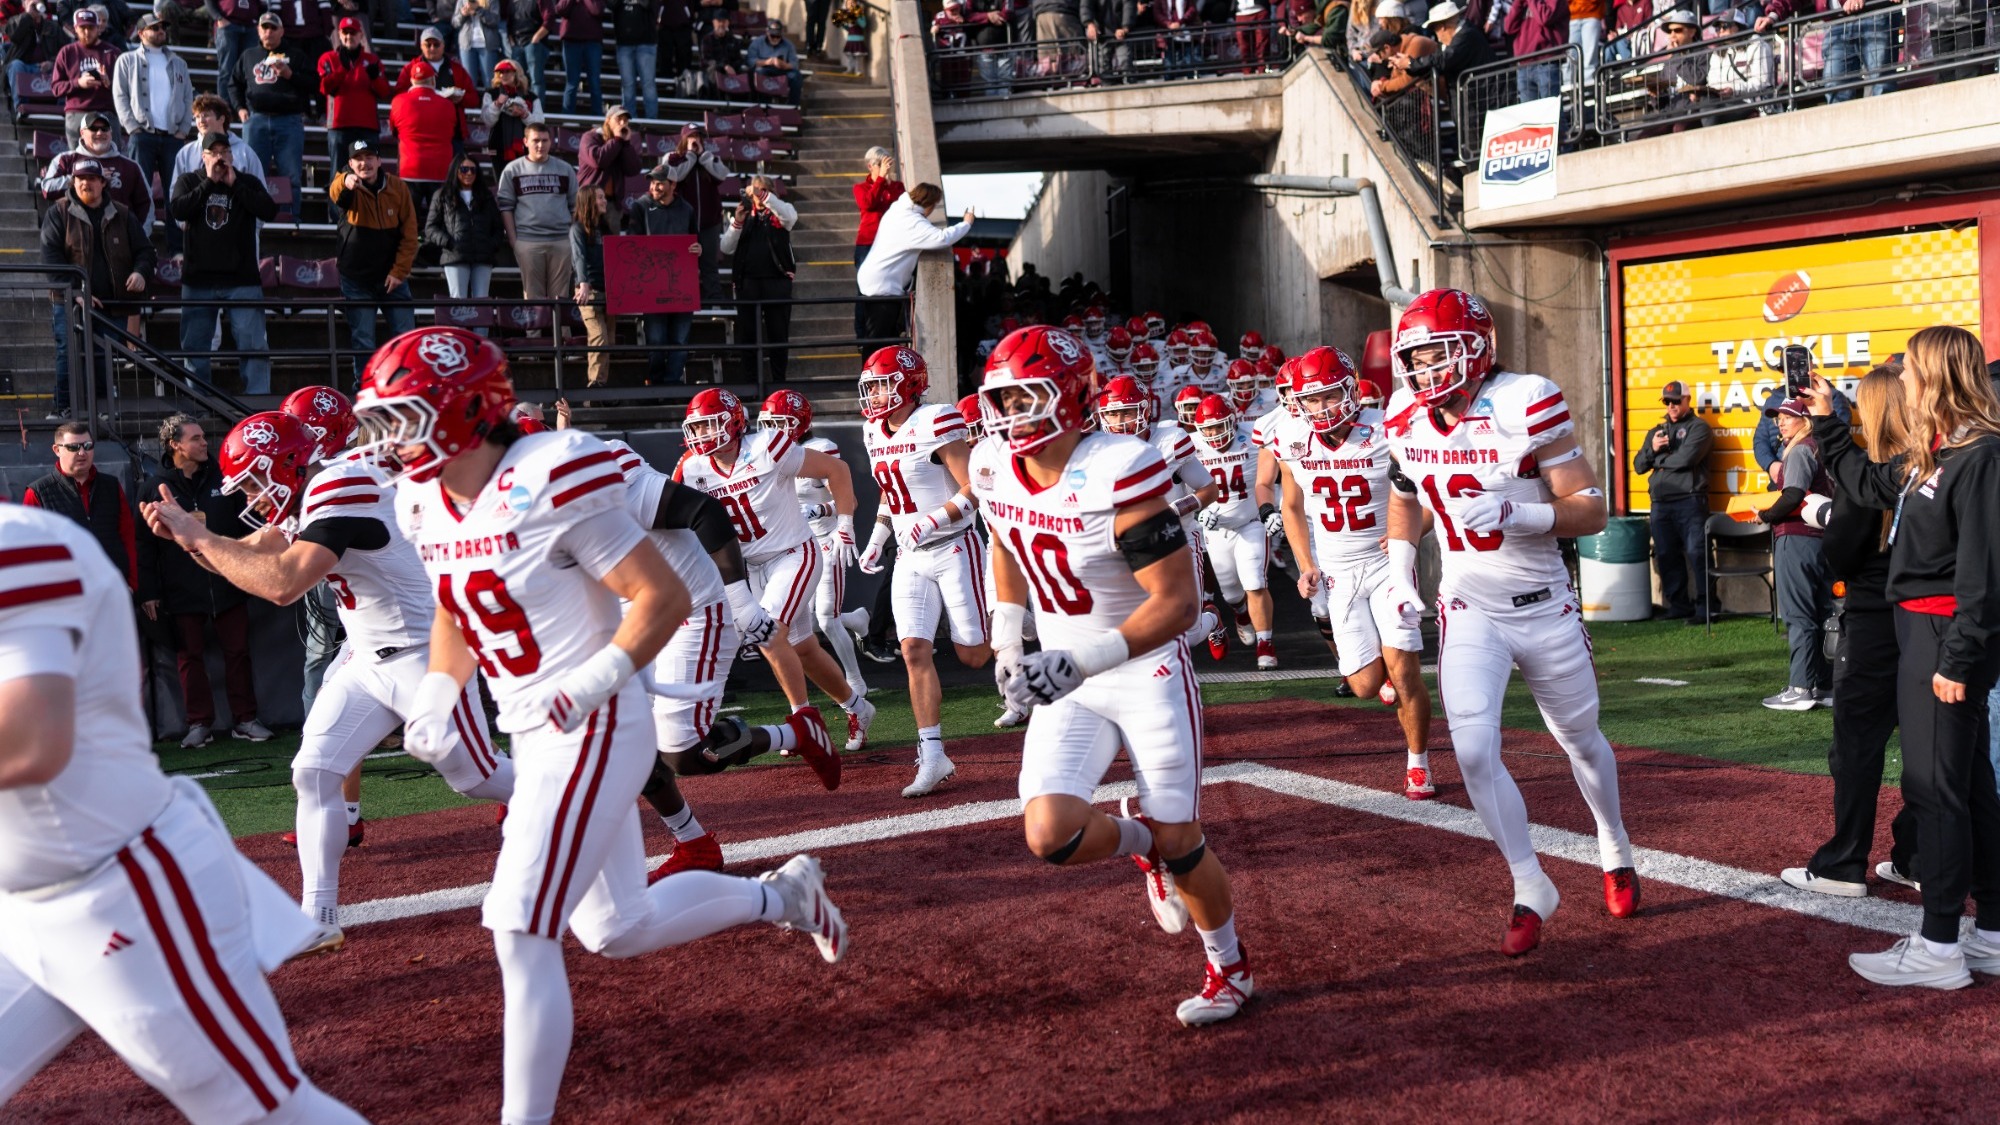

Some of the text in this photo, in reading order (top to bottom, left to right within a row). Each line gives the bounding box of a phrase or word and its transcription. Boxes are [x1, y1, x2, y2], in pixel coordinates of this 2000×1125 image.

[1489, 133, 1552, 158] town
[1487, 149, 1550, 177] pump
[1712, 427, 1753, 438] CURITY
[1301, 457, 1374, 471] SOUTH DAKOTA
[1404, 446, 1499, 465] SOUTH DAKOTA
[728, 475, 760, 494] DAKOTA
[874, 459, 919, 515] 81
[1209, 464, 1249, 504] 94
[719, 492, 769, 543] 91
[1312, 474, 1377, 533] 32
[1028, 508, 1085, 535] DAKOTA
[420, 530, 521, 563] OUTH DAKOTA
[1008, 526, 1095, 617] 10
[438, 568, 543, 679] 19
